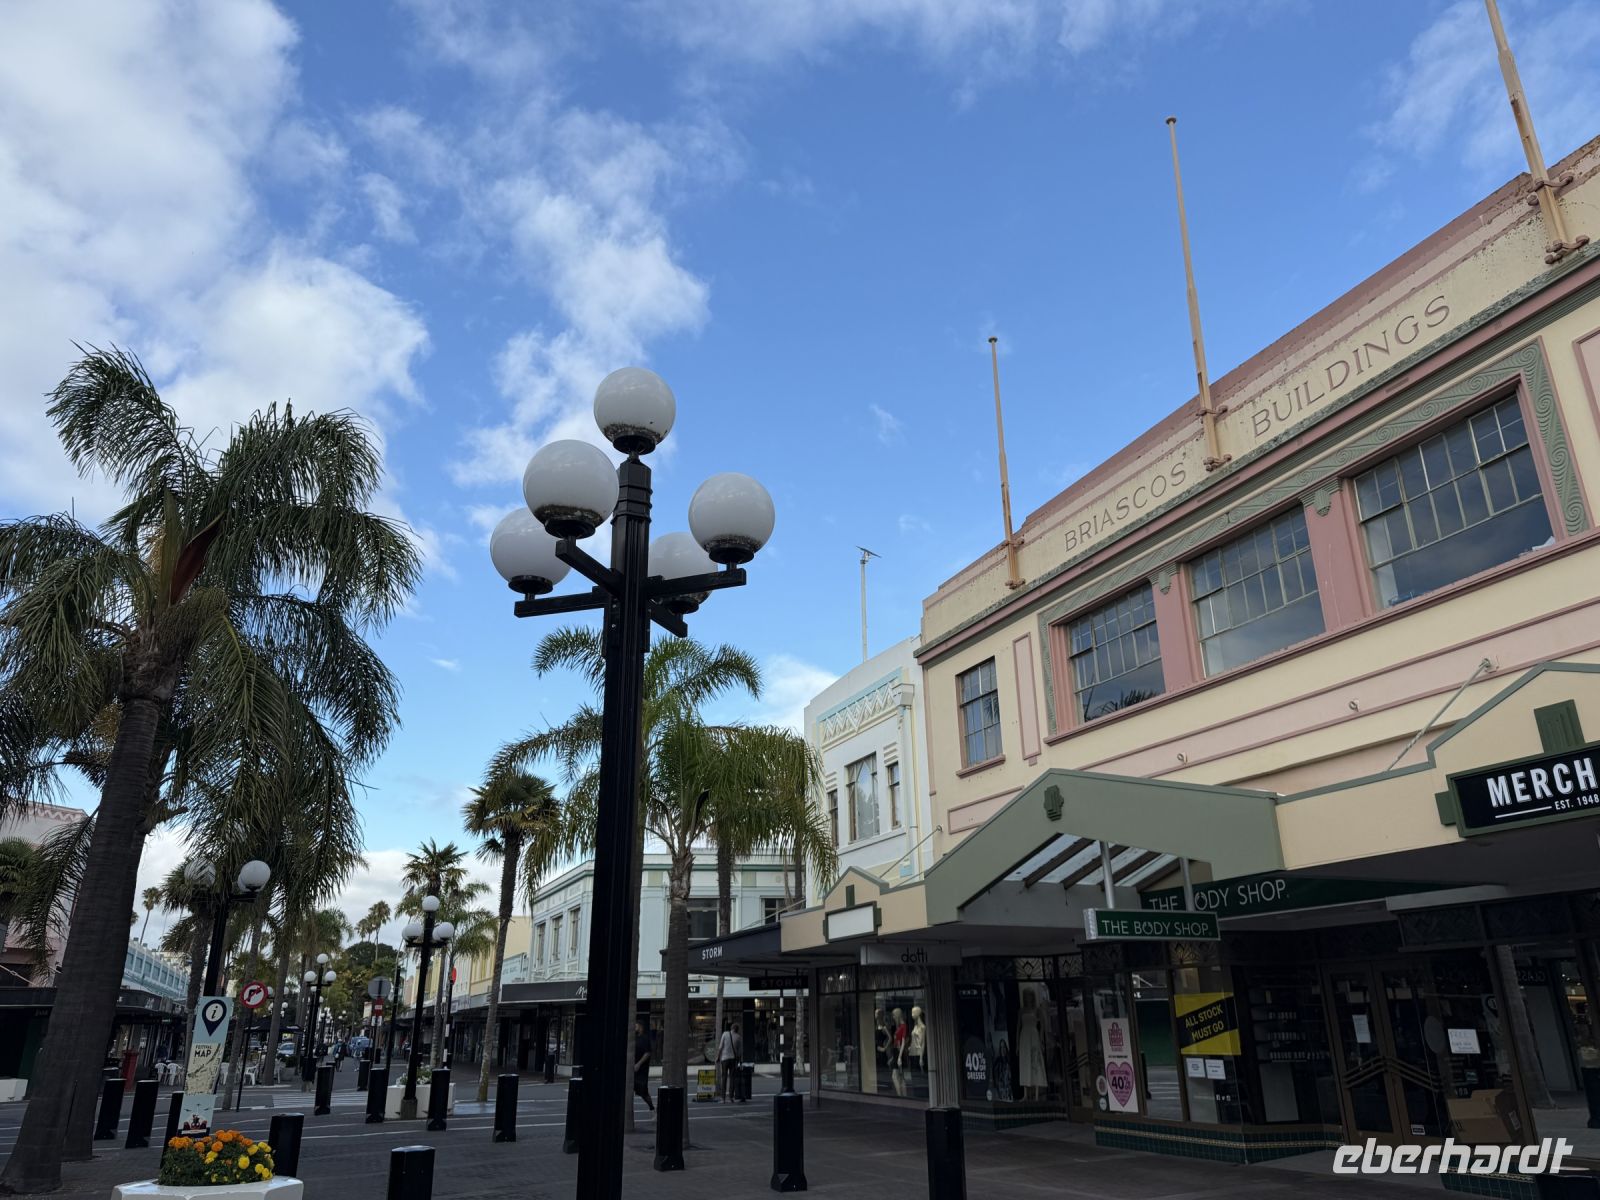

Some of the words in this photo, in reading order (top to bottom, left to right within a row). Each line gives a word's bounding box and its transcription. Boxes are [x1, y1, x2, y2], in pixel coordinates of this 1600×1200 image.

[1251, 294, 1451, 438] BUILDINGS
[1554, 799, 1574, 811] EST.
[1149, 895, 1178, 910] THE
[1194, 887, 1229, 911] ODY
[1101, 920, 1129, 935] THE
[1134, 921, 1171, 936] BODY
[701, 945, 723, 960] STORM
[901, 947, 928, 963] dotti
[761, 978, 802, 988] STORM
[1185, 1015, 1199, 1029] ALL
[1199, 1003, 1223, 1023] STOCK
[1191, 1025, 1212, 1042] MUST
[1212, 1020, 1225, 1033] GO
[194, 1050, 212, 1058] MAP
